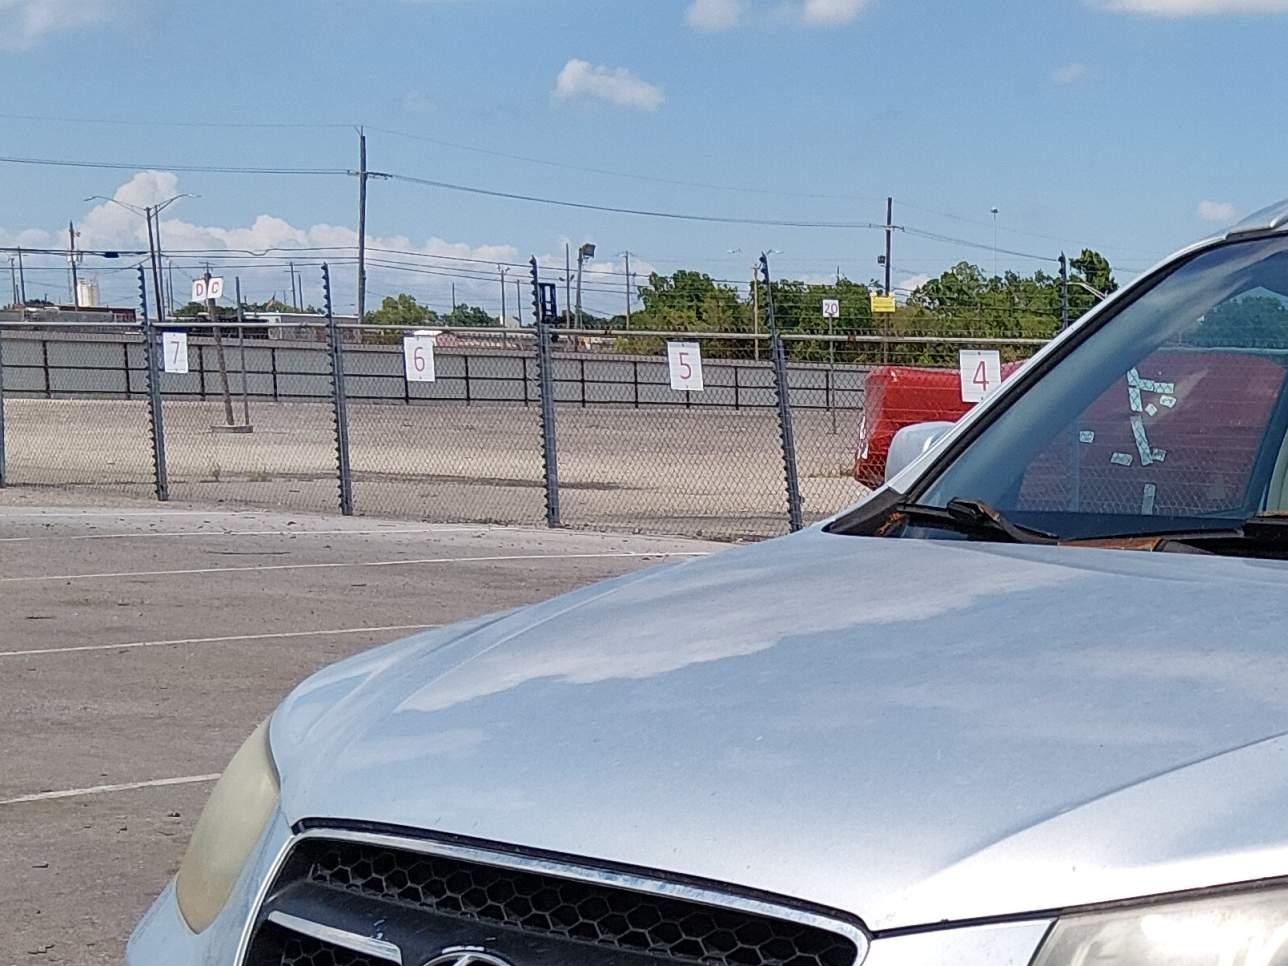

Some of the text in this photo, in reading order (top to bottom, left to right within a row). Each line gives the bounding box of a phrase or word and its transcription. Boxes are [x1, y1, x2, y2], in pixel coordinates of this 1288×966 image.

[196, 283, 203, 296] D
[823, 302, 838, 316] 20
[171, 340, 180, 364] 7
[413, 346, 425, 373] 6
[679, 352, 692, 379] 5
[972, 360, 990, 391] 4
